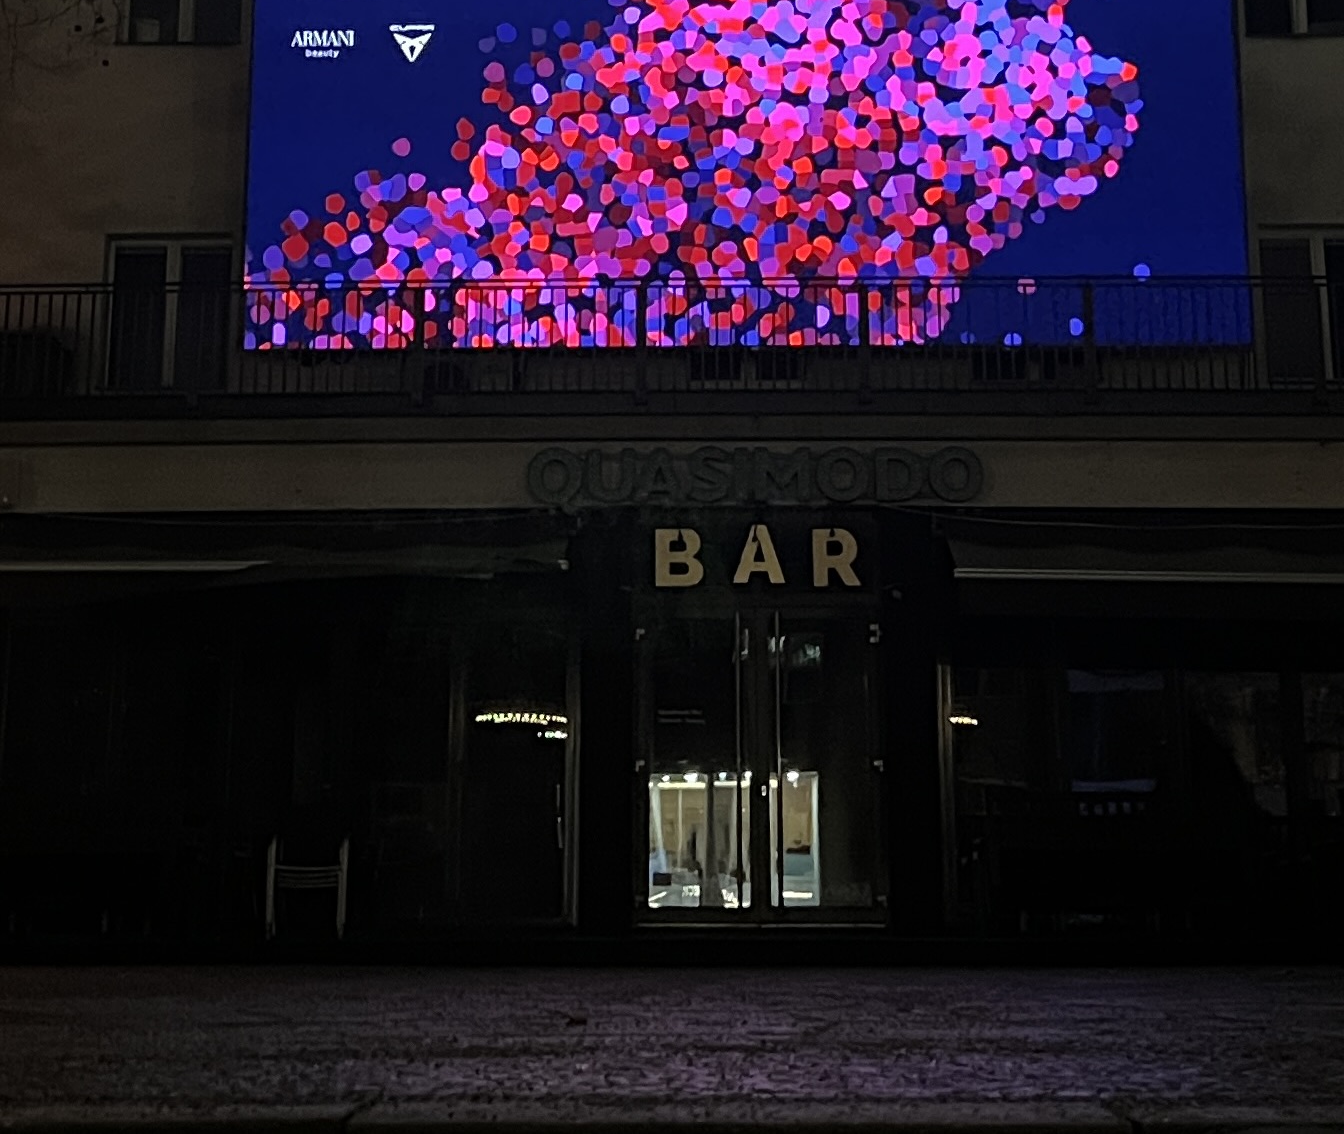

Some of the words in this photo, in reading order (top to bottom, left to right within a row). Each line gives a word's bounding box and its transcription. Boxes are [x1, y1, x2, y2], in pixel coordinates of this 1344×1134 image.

[290, 29, 356, 48] ARMANI
[304, 48, 340, 59] beauty
[526, 445, 985, 514] QUASIMODO
[654, 523, 863, 588] BAR
